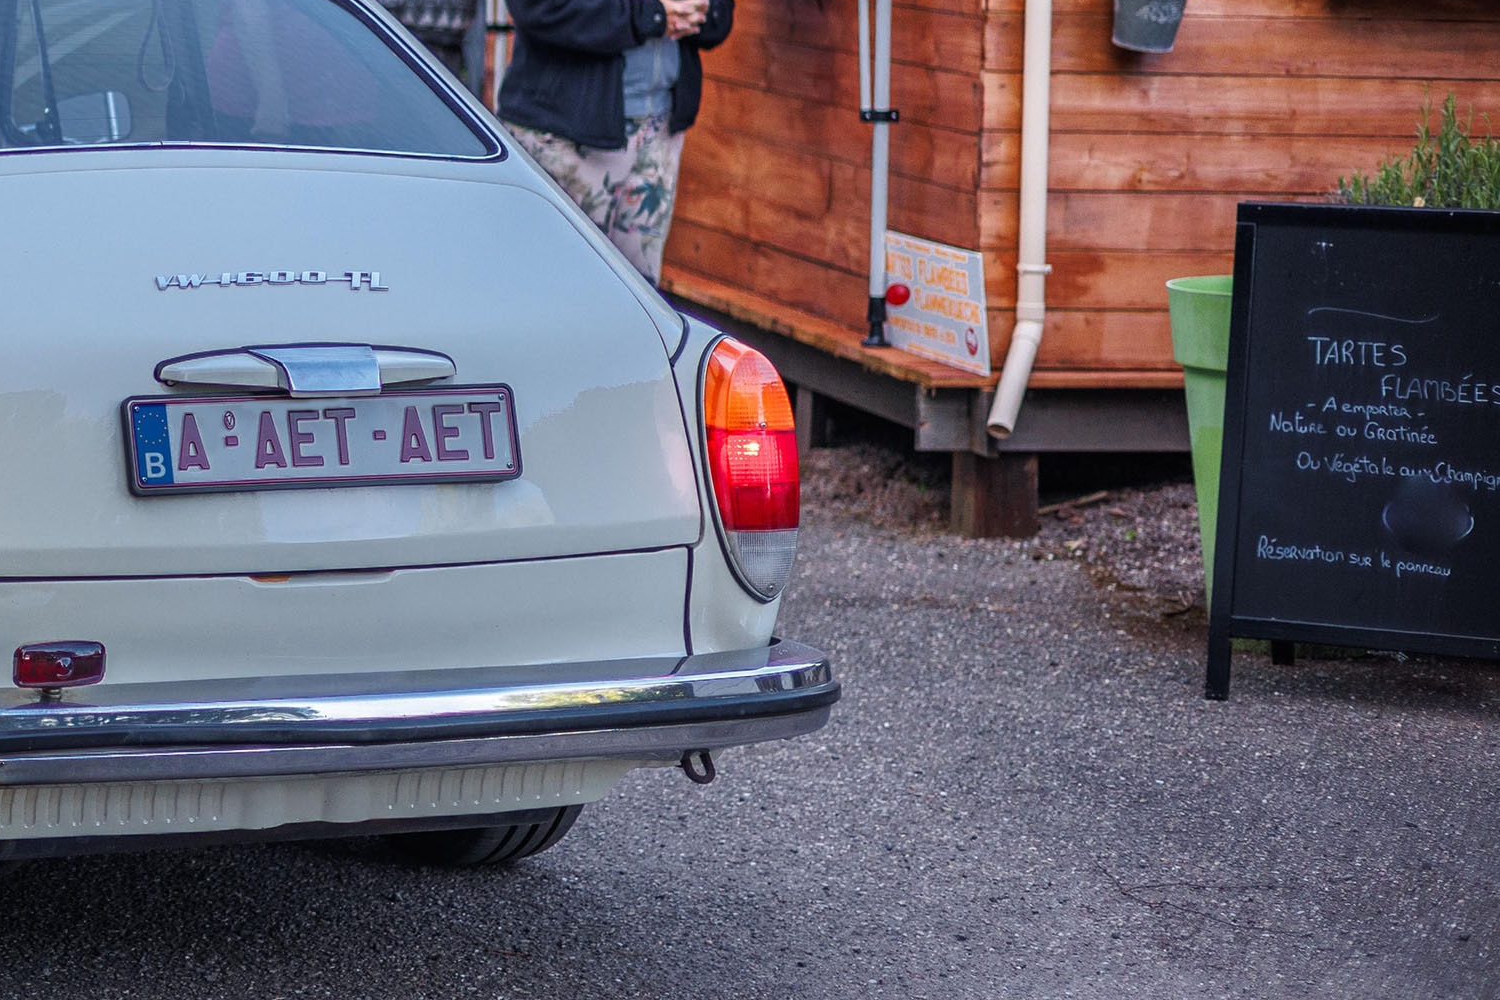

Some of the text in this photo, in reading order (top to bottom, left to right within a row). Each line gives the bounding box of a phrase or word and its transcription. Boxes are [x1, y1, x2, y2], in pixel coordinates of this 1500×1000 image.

[155, 270, 389, 291] VW 1600 TL
[1308, 336, 1407, 367] TARTES
[1270, 411, 1327, 434] Nature
[1336, 425, 1357, 437] ou
[144, 452, 166, 479] B
[1297, 451, 1321, 470] Ou
[1349, 553, 1372, 567] sur
[1381, 552, 1391, 568] le
